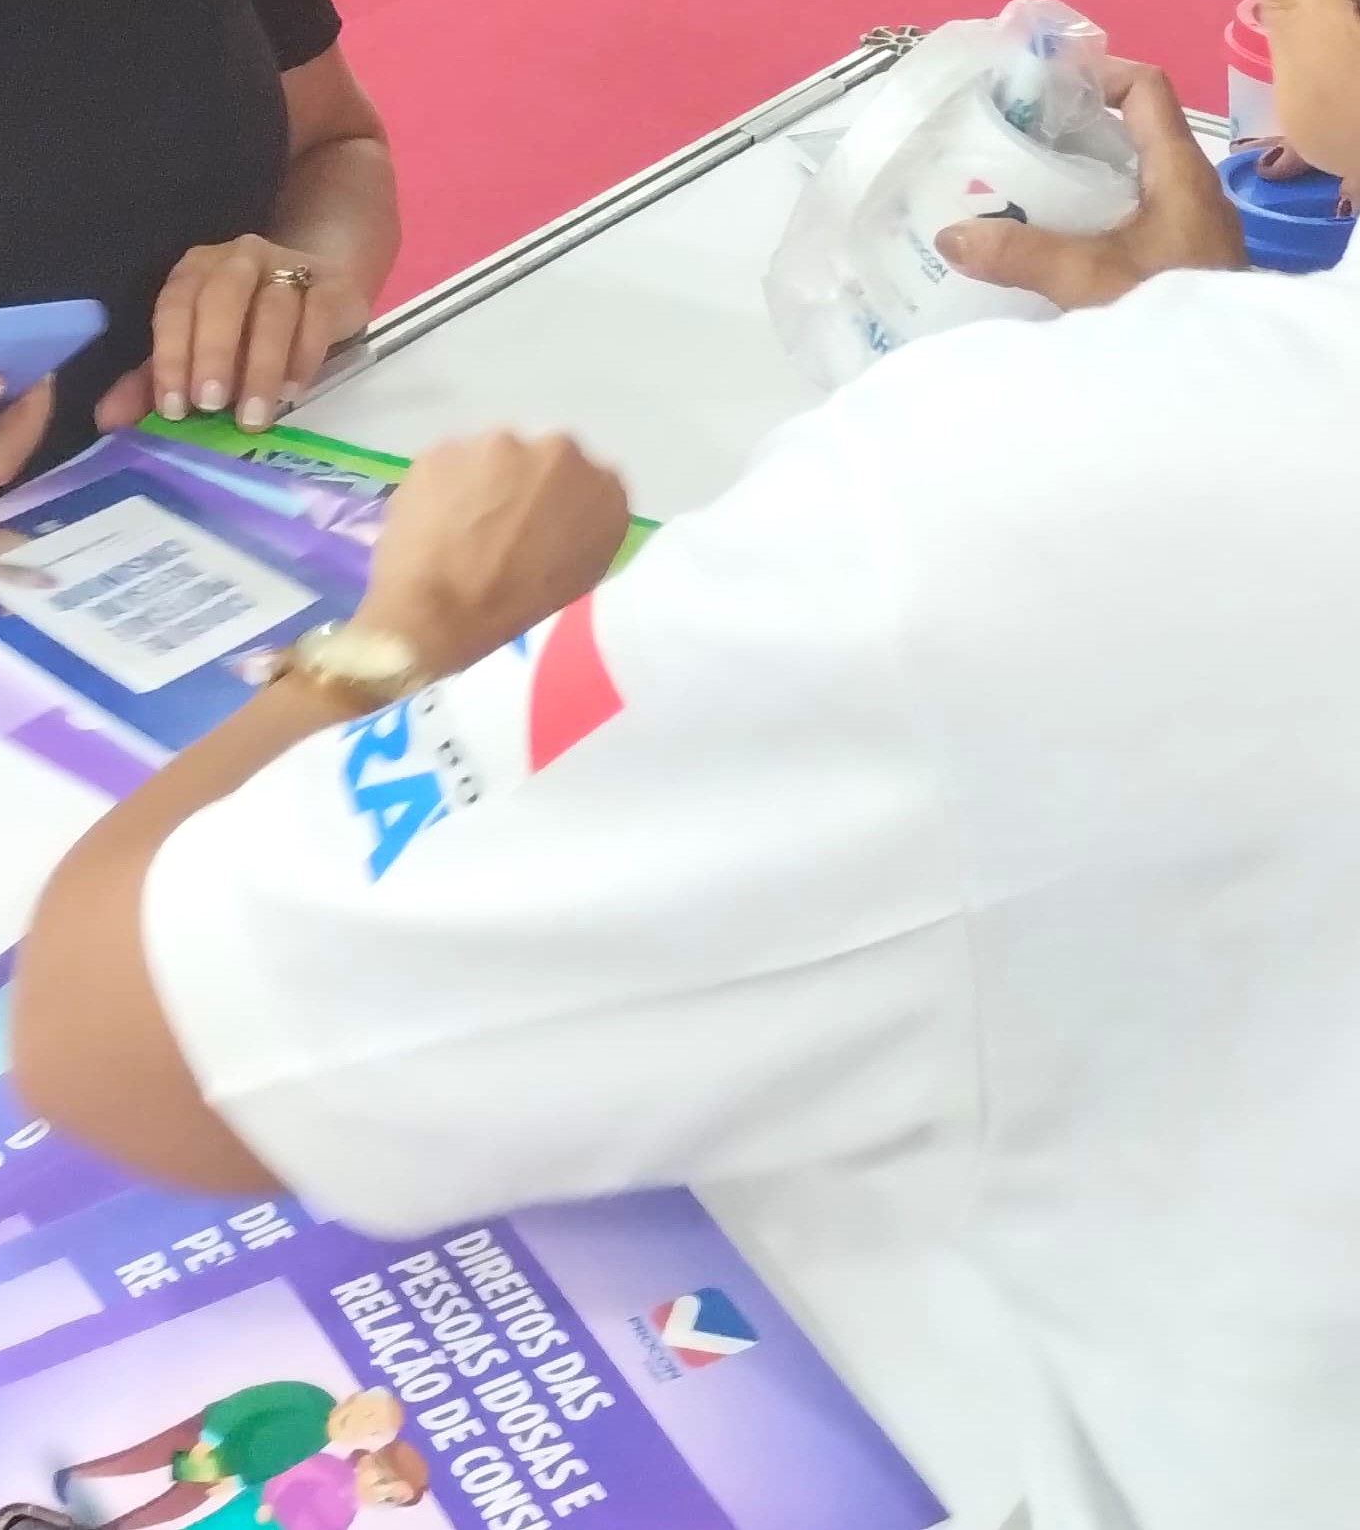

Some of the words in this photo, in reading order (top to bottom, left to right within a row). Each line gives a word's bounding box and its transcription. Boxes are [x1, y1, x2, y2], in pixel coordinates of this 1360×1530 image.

[330, 1272, 452, 1403] RELAÇÃO
[416, 1396, 487, 1452] DE
[387, 1250, 511, 1378] PESSOAS
[473, 1370, 590, 1490] IDOSAS
[551, 1481, 608, 1518] E
[443, 1228, 570, 1358] DIREITOS
[533, 1351, 617, 1421] DAS
